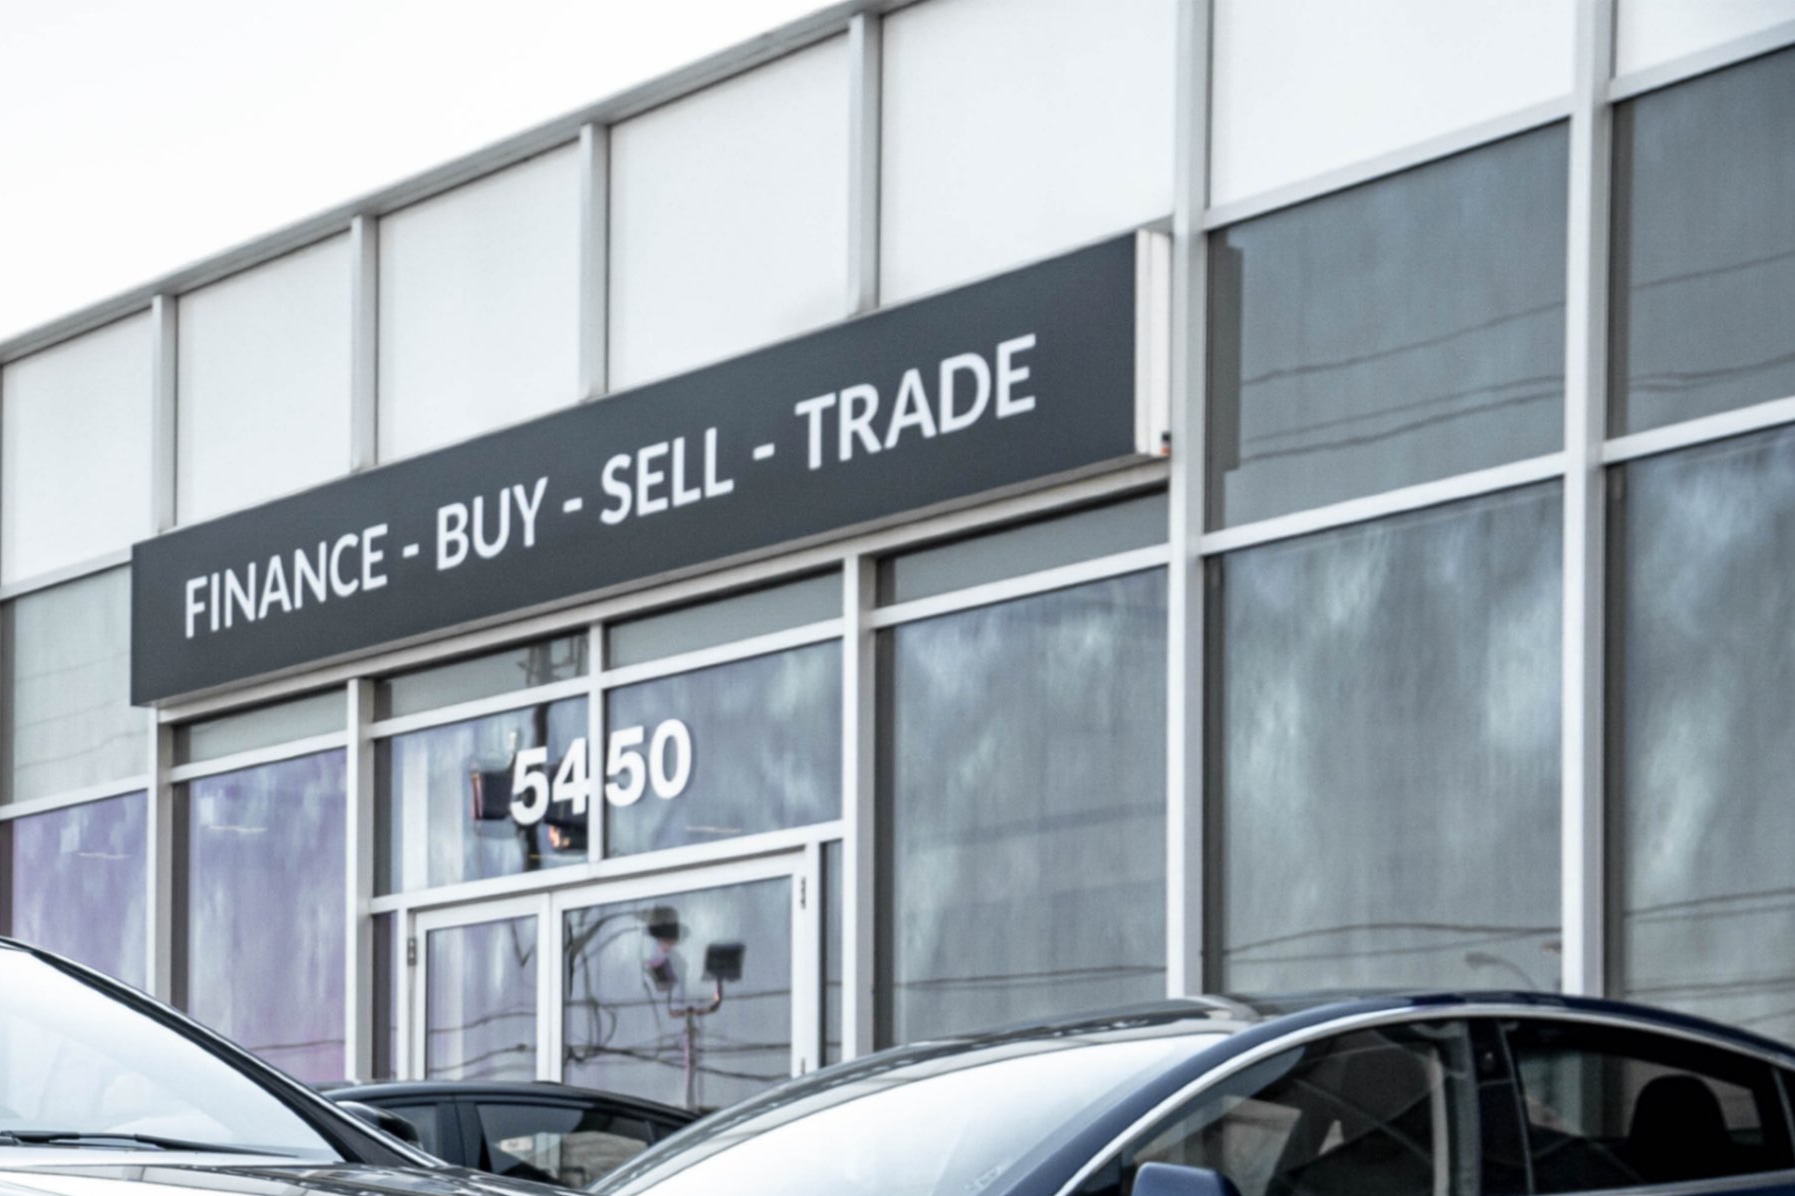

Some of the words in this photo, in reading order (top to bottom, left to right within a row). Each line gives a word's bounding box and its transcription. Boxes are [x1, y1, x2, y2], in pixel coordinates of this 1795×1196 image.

[184, 523, 388, 639] FINANCE
[436, 476, 548, 571] BUY
[599, 427, 735, 525] SELL
[794, 333, 1036, 470] TRADE
[510, 718, 692, 825] 5450
